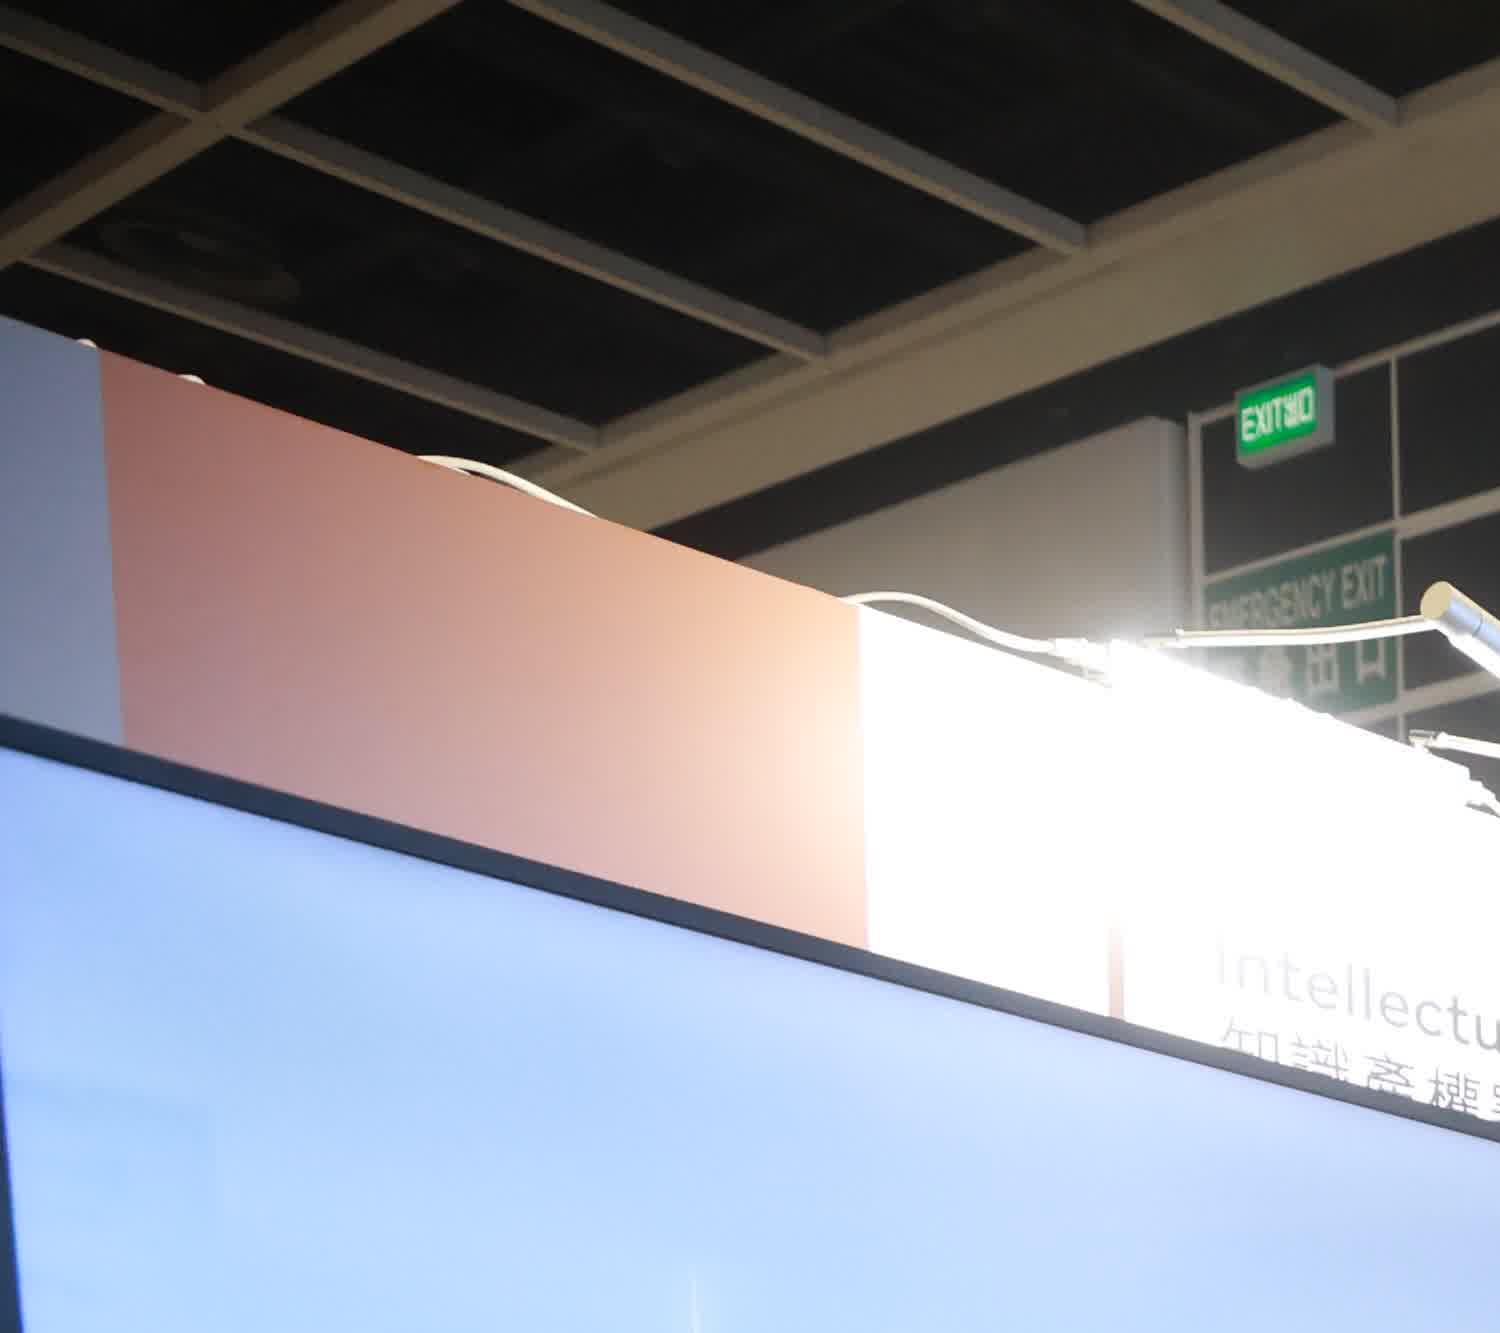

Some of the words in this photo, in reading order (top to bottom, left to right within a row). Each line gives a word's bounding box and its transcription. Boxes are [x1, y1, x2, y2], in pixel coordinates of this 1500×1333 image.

[1241, 398, 1284, 443] EXIT
[1207, 572, 1334, 630] EMERGENCY
[1341, 555, 1388, 609] EXIT
